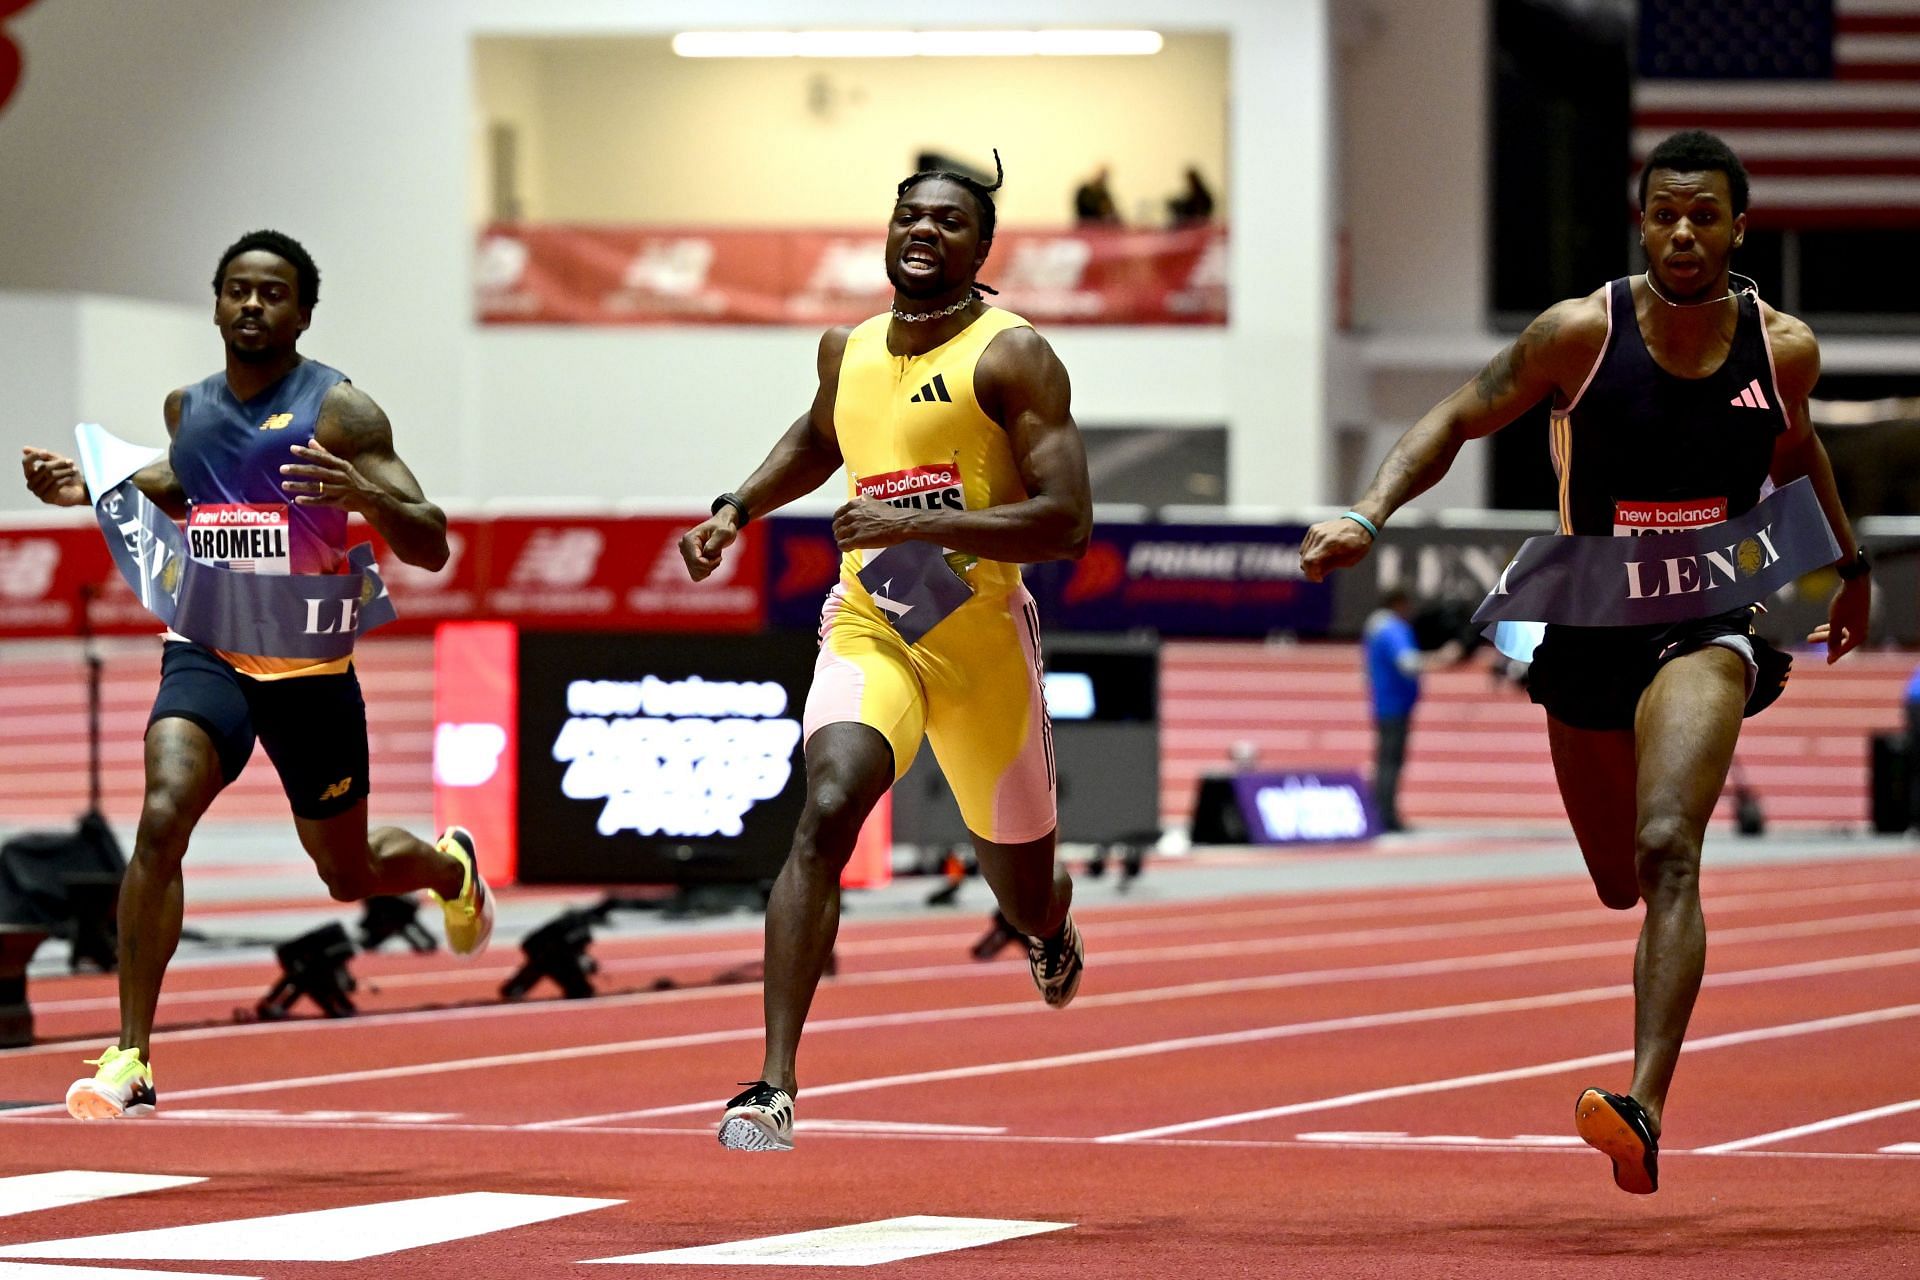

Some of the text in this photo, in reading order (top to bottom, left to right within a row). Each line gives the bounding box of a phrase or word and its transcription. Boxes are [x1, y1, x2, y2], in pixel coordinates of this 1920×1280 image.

[861, 471, 952, 497] new balance
[195, 508, 281, 524] new balance
[1619, 507, 1720, 523] new balance
[191, 528, 286, 559] BROMELL
